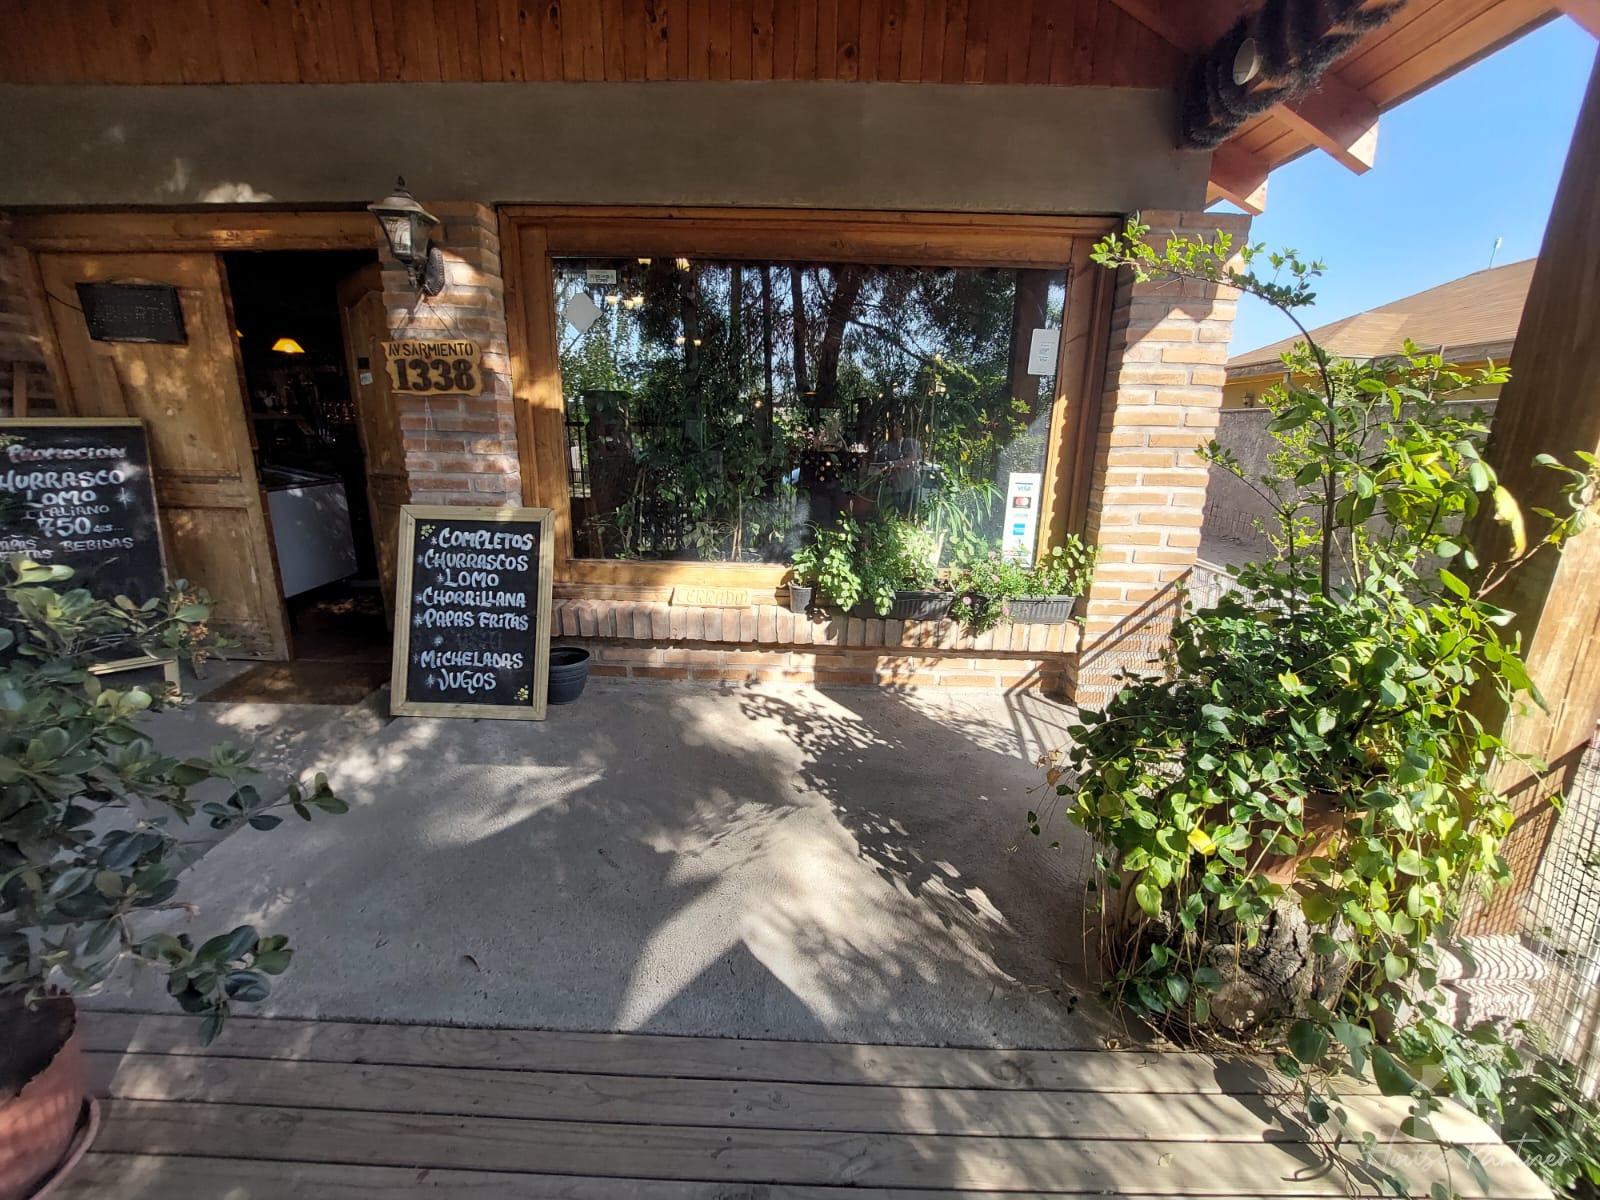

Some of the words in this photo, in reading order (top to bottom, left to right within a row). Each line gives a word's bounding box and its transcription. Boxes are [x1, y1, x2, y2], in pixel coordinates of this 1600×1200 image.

[402, 342, 473, 357] SARMIENTO
[394, 358, 476, 391] 1338
[22, 490, 97, 508] LOMO
[37, 516, 91, 538] 750
[438, 527, 534, 550] COMPLETOS
[424, 549, 529, 571] CHURRASCOS
[443, 567, 499, 587] LOMO
[423, 608, 475, 628] PAPAS
[438, 668, 497, 694] JUGOS
